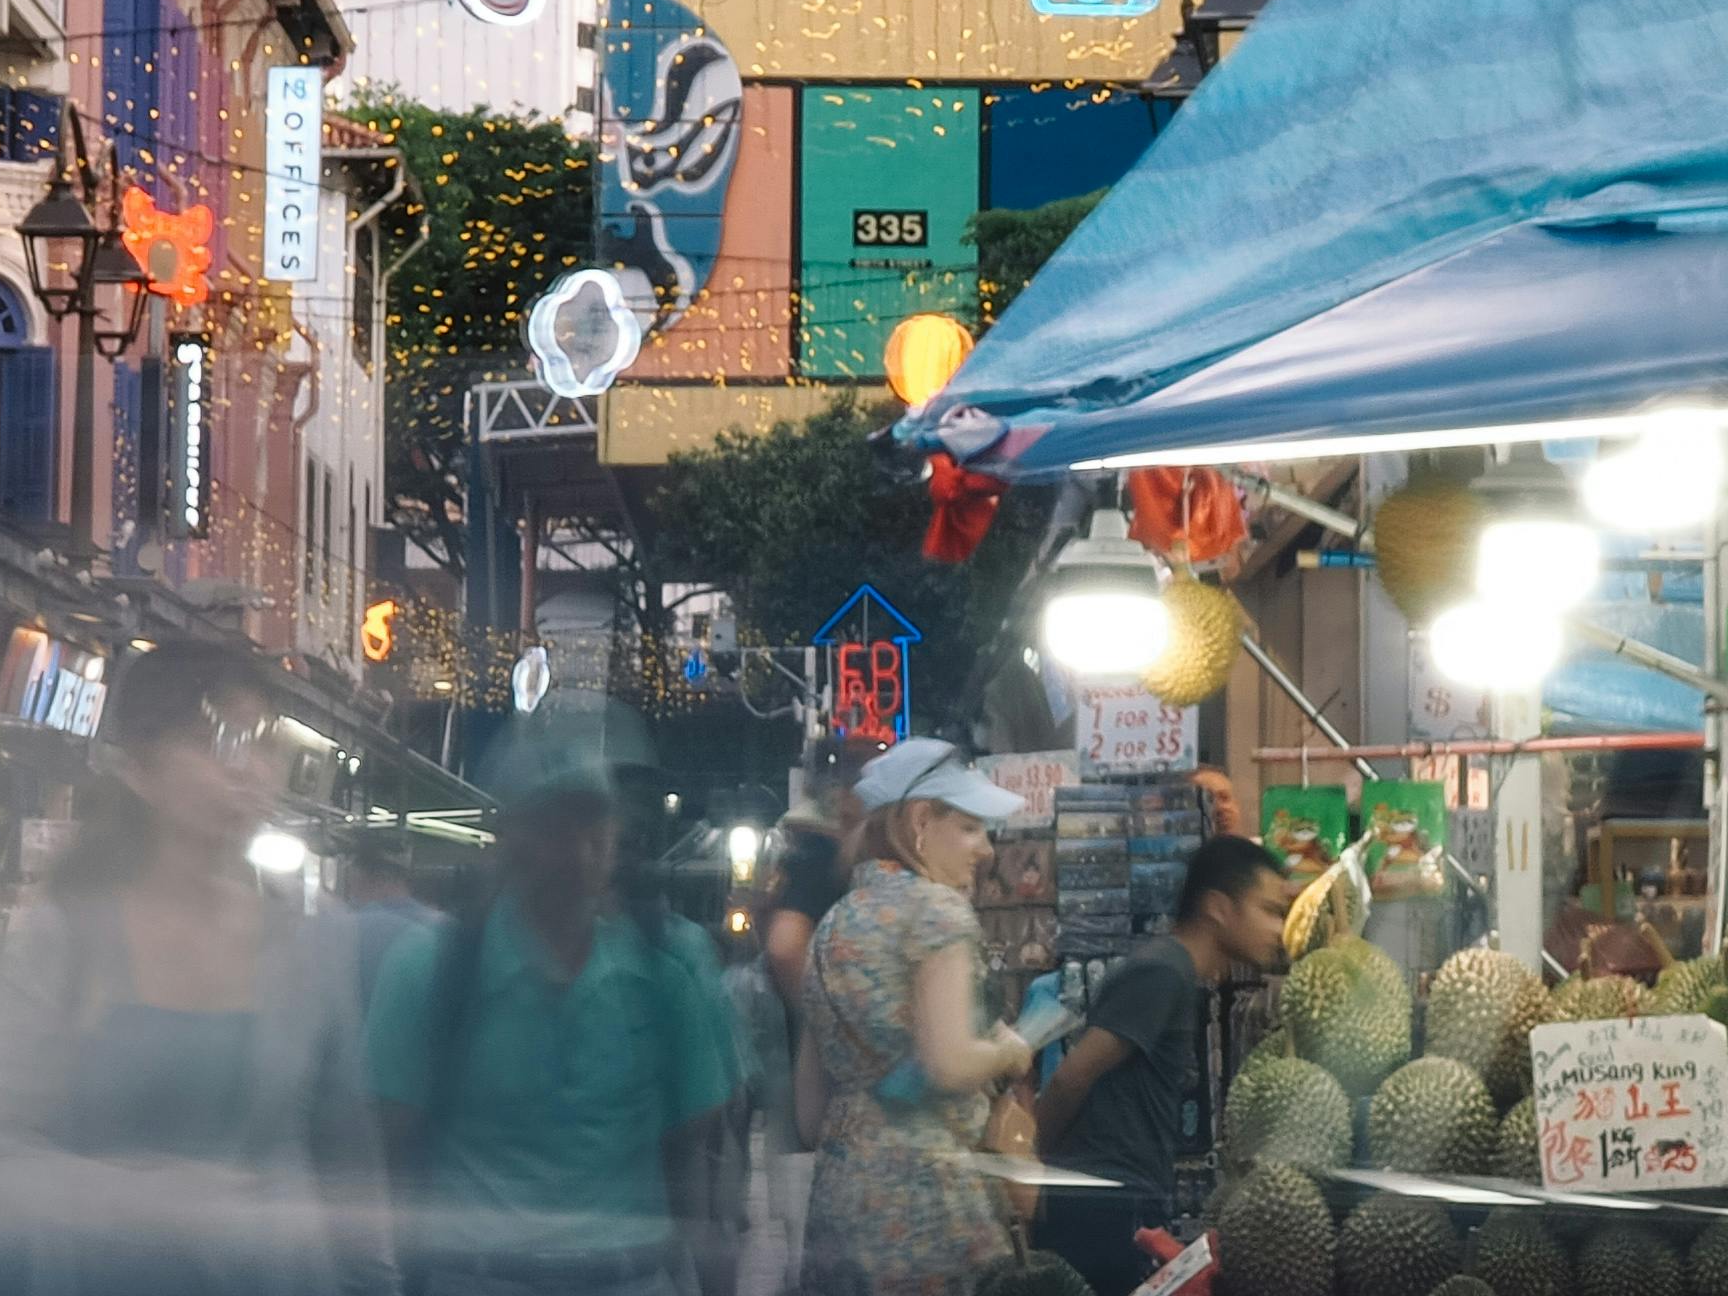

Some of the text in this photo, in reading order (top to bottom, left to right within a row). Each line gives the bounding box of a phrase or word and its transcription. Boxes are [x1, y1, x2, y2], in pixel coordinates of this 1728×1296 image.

[280, 111, 304, 270] OFFICES
[856, 213, 923, 243] 335
[1114, 709, 1149, 730] FOR
[1090, 732, 1105, 761] 2
[1114, 740, 1148, 758] FOR
[1652, 1060, 1697, 1080] King
